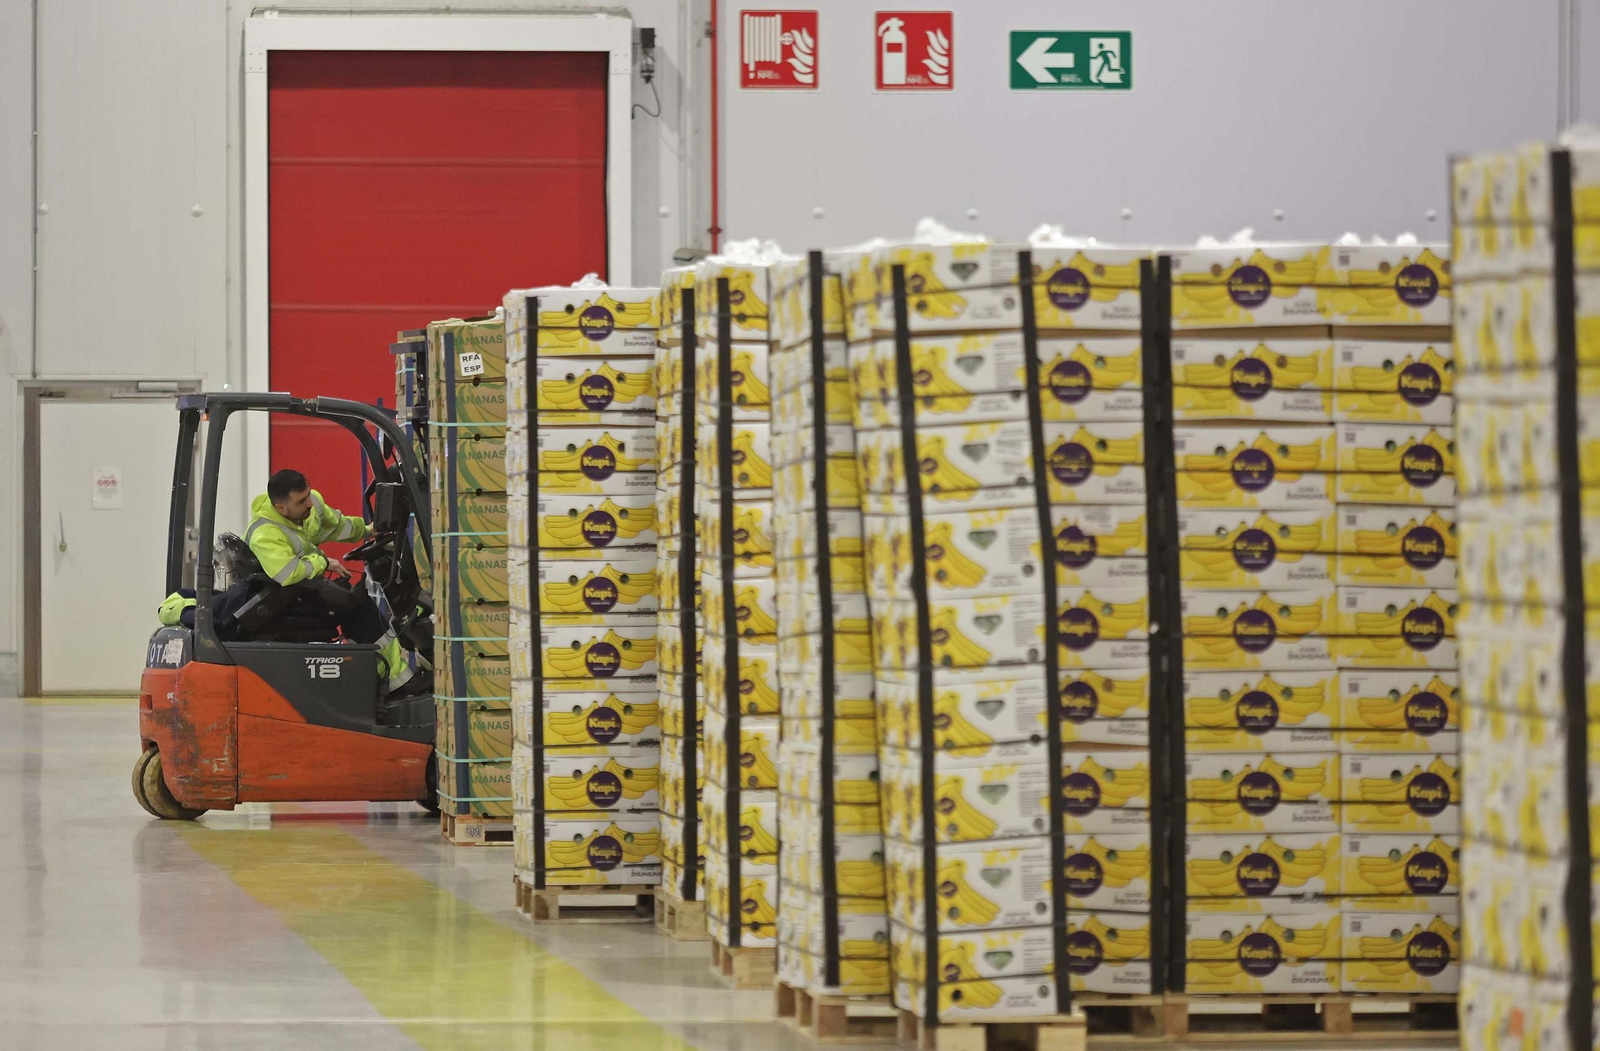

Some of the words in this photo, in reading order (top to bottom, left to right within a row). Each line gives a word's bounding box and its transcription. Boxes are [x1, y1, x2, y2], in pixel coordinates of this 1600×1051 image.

[581, 316, 608, 328] Kapi
[462, 354, 480, 363] RFA
[464, 365, 481, 373] ESP
[1401, 375, 1433, 392] Kapi
[581, 385, 608, 398] Kapi
[583, 456, 610, 469] Kapi
[1404, 456, 1436, 472] Kapi
[584, 521, 611, 535] Kapi
[1405, 539, 1437, 555] Kapi
[585, 587, 612, 600] Kapi
[1405, 619, 1437, 635] Kapi
[587, 653, 615, 666] Kapi
[307, 664, 341, 679] 18
[1408, 704, 1440, 721] Kapi
[588, 717, 616, 731] Kapi
[589, 782, 616, 795] Kapi
[1410, 784, 1442, 801] Kapi
[590, 846, 617, 859] Kapi
[1408, 864, 1440, 881] Kapi
[1410, 944, 1442, 959] Kapi
